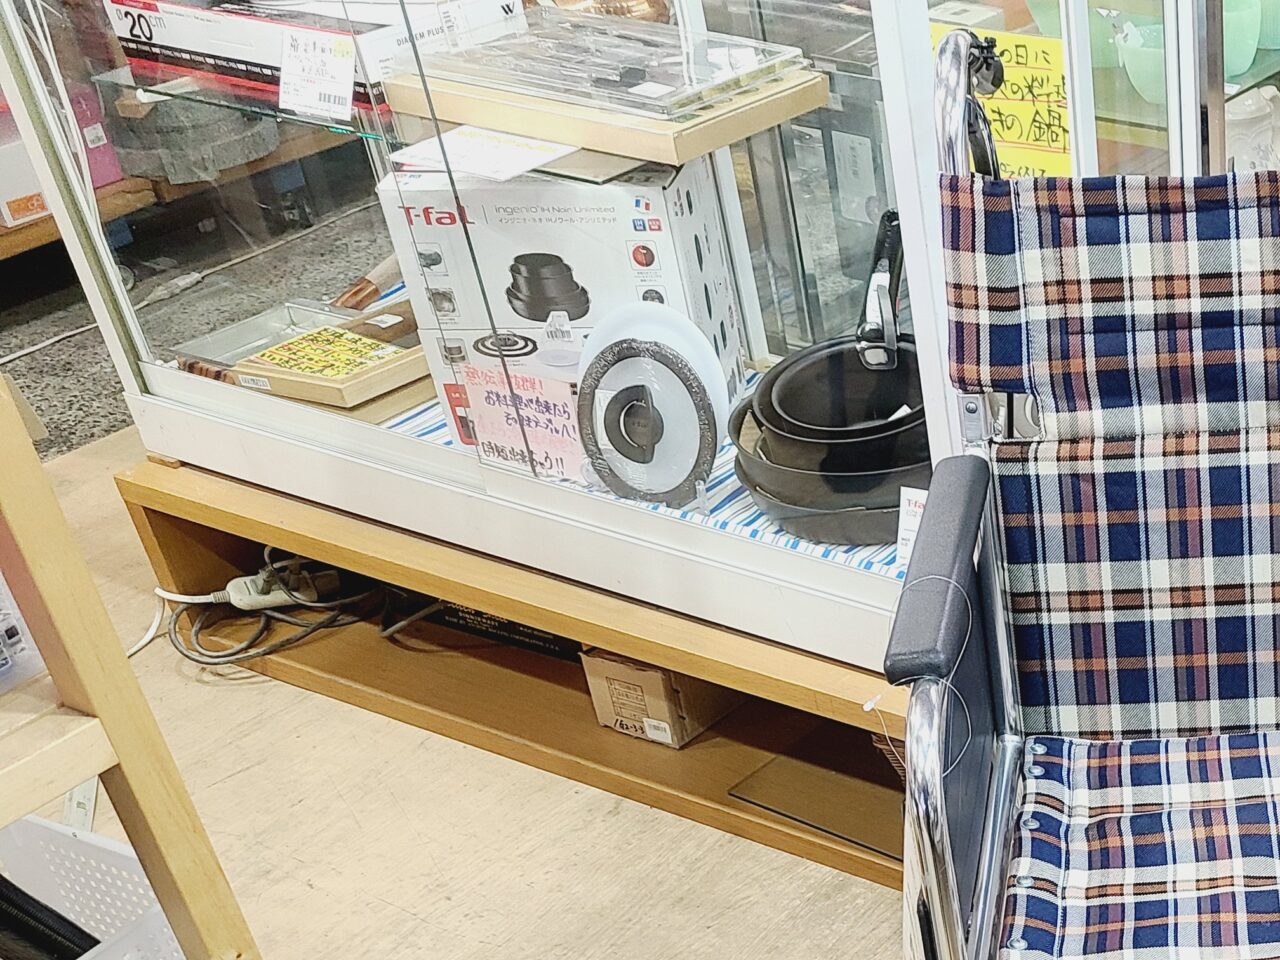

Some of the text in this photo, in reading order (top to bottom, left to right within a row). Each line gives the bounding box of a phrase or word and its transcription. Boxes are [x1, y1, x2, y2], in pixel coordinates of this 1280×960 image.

[396, 26, 445, 46] DIAEM PLUS
[398, 205, 475, 226] T-fal
